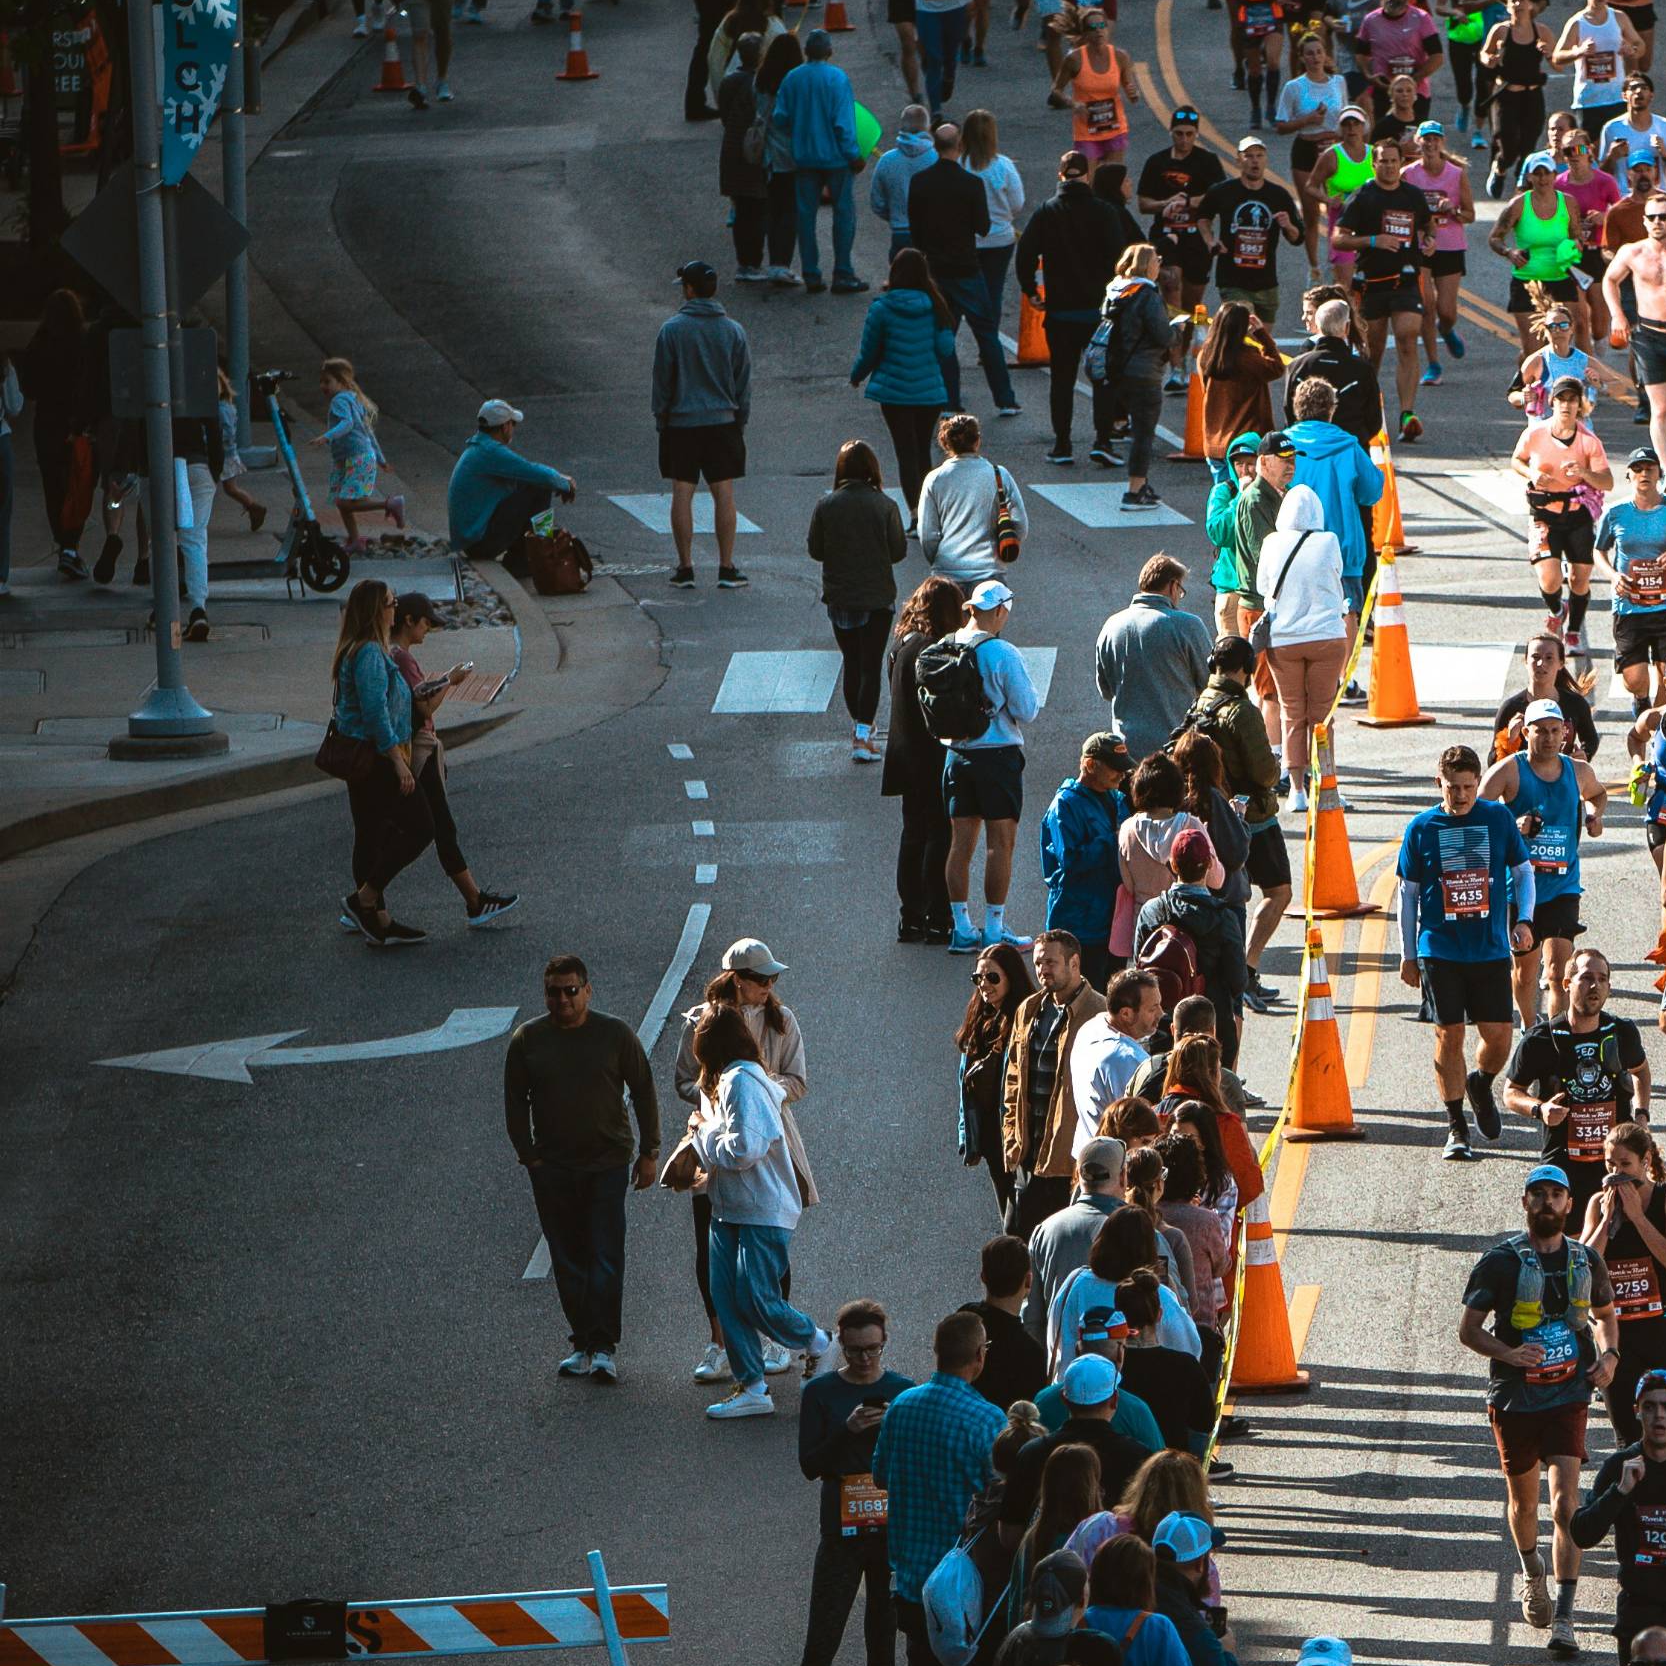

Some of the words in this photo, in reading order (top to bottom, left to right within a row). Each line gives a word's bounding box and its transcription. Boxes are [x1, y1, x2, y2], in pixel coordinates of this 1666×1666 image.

[1637, 577, 1662, 585] 4154
[1530, 845, 1565, 856] 20681
[1451, 891, 1483, 902] 3435
[1576, 1125, 1609, 1137] 3345
[1616, 1279, 1649, 1295] 2759
[848, 1498, 888, 1513] 31687
